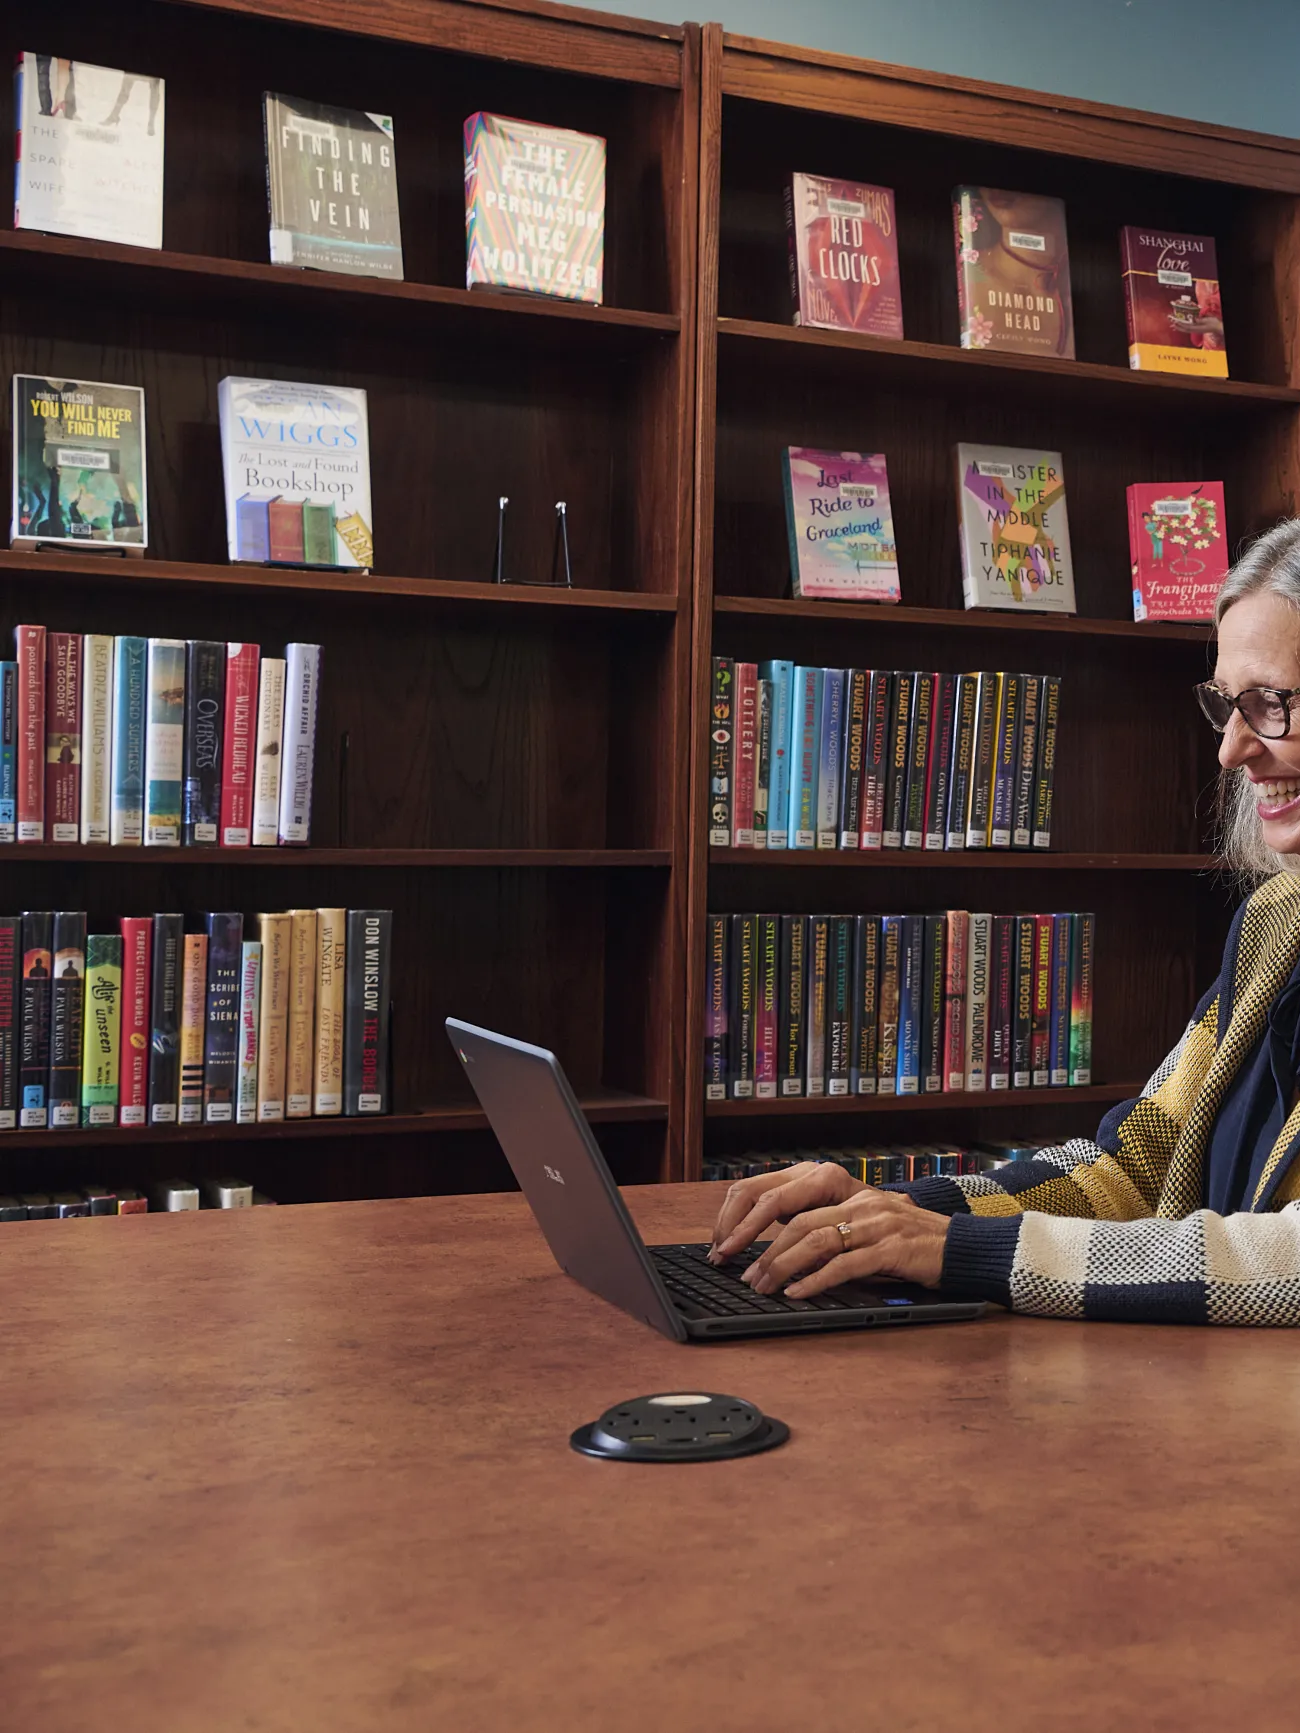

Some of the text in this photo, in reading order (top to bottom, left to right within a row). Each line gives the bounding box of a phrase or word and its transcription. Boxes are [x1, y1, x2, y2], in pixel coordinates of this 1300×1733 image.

[282, 126, 390, 167] FINDING
[523, 141, 567, 171] THE
[316, 167, 360, 195] THE
[502, 167, 586, 202] FEMALE
[310, 199, 370, 230] VEIN
[485, 190, 600, 229] PERSUASION
[518, 222, 566, 253] MEG
[831, 214, 863, 247] RED
[1139, 235, 1204, 255] SHANGHAI
[483, 246, 597, 288] WOLITZER
[819, 248, 881, 286] CLOCKS
[988, 290, 1054, 313] DIAMOND
[1005, 313, 1041, 331] HEAD
[31, 399, 132, 422] YOU WILL NEVER
[60, 391, 94, 405] WILSON
[68, 420, 120, 438] FIND ME
[239, 416, 357, 448] WIGGS
[258, 452, 288, 467] Lost
[315, 457, 359, 474] Found
[817, 470, 854, 488] Last
[246, 468, 354, 501] Bookshop
[987, 486, 1046, 504] IN THE
[809, 495, 875, 518] Ride to
[987, 509, 1049, 528] MIDDLE
[806, 517, 882, 541] Graceland
[980, 542, 1061, 562] TIPHANIE
[982, 566, 1064, 585] YANIQUE
[68, 640, 76, 658] ALL
[57, 645, 66, 717] SAID GOODBYE
[67, 681, 75, 707] WAYS
[129, 669, 140, 719] HUNDRED
[25, 646, 38, 750] postcards from the past
[93, 644, 107, 755] BEATRIZ WILLIAMS
[300, 673, 310, 735] ORCHID AFFAIR
[67, 710, 75, 724] WE
[195, 699, 218, 768] OVERSEAS
[743, 686, 755, 760] LOTTERY
[829, 681, 840, 771] SHERRYL WOODS
[850, 673, 865, 771] STUART WOODS
[128, 723, 139, 772] SUMMERS
[232, 695, 250, 783] WICKED REDHEAD
[321, 927, 332, 986] WINGATE
[335, 943, 344, 970] LISA
[363, 918, 380, 1042] DON WINSLOW THE
[971, 919, 987, 1063] STUART WOODS PALINDROME
[92, 976, 119, 1053] Alif unseen
[133, 931, 146, 1080] PERFECT LITTLE WORLD KEVIN
[831, 1022, 840, 1072] EXPOSURE
[883, 1022, 896, 1074] KISSER
